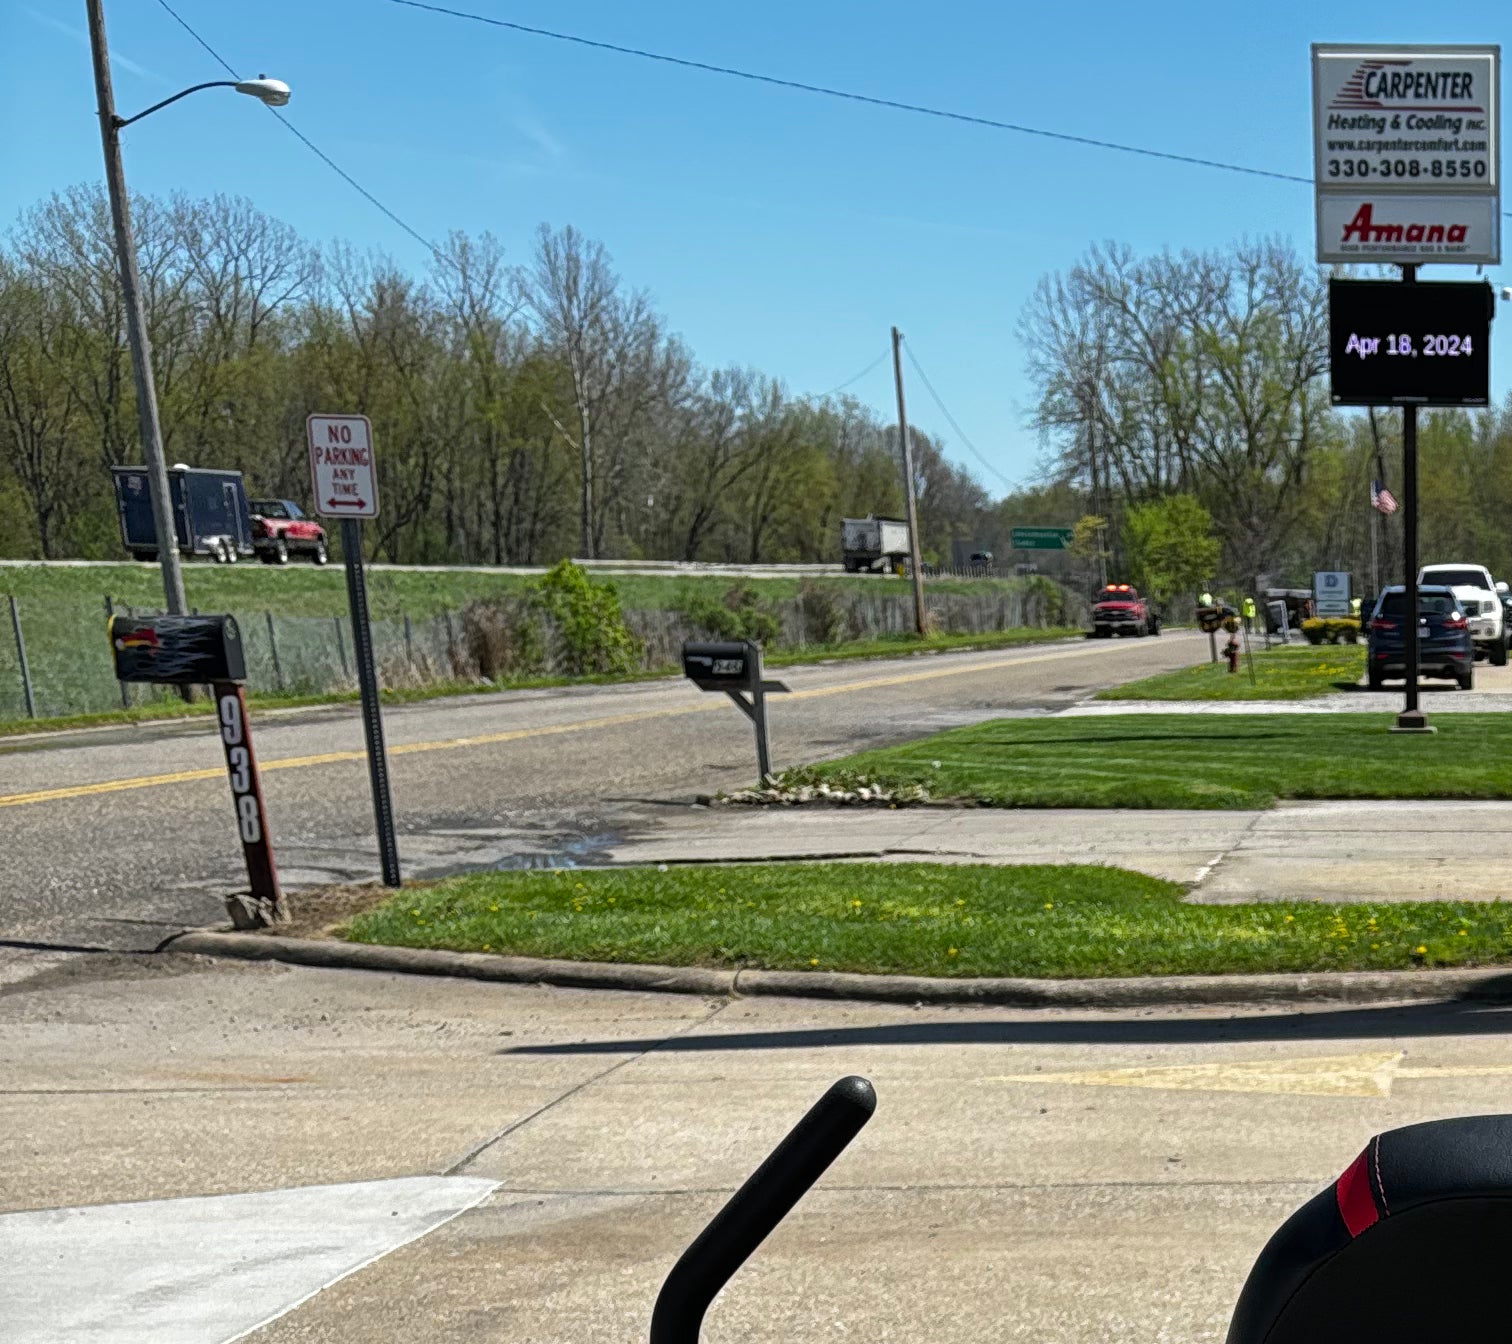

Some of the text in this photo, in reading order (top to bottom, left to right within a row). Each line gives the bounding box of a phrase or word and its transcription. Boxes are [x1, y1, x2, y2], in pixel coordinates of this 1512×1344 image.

[1365, 71, 1474, 99] CARPENTER
[1327, 113, 1387, 134] Heating
[1390, 114, 1401, 130] &
[1406, 114, 1464, 135] Cooling
[1327, 138, 1487, 153] www.carpentercomfort.com
[1341, 203, 1469, 242] Amana
[1345, 333, 1473, 360] Apr 18, 2024
[328, 425, 352, 443] NO
[315, 447, 369, 466] PARKING
[333, 468, 355, 480] ANY
[332, 483, 359, 496] TIME
[220, 695, 261, 843] 938
